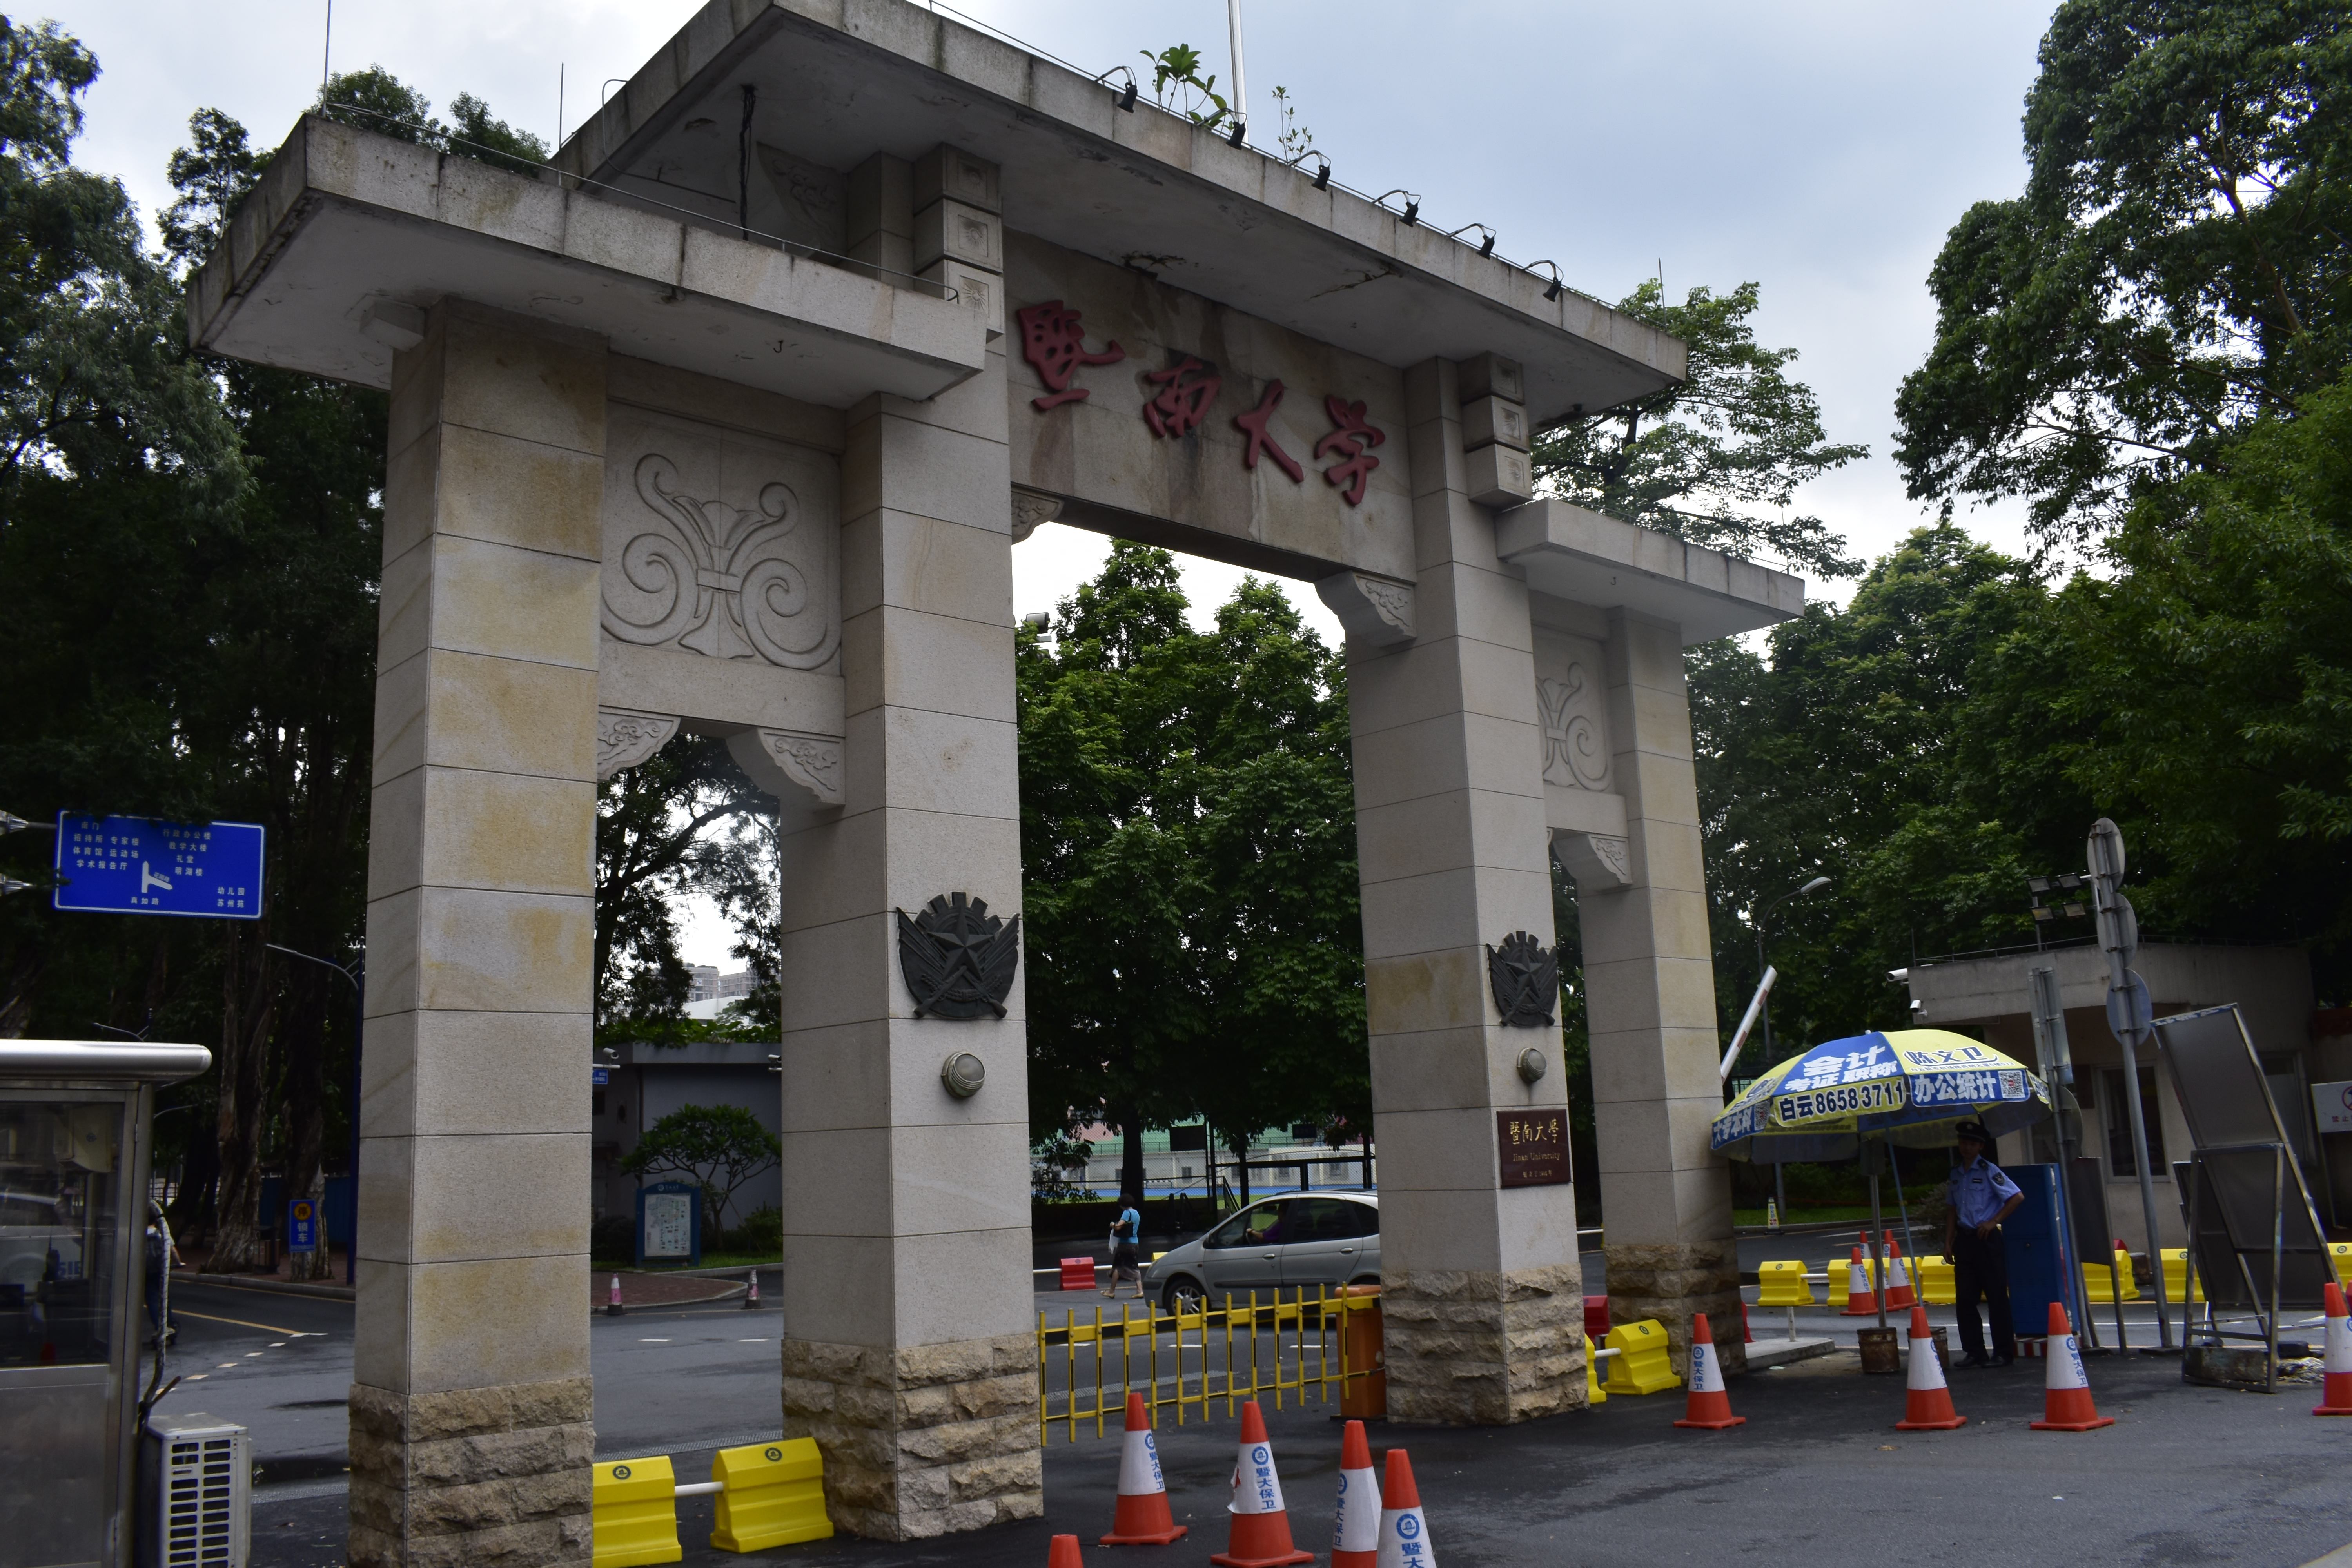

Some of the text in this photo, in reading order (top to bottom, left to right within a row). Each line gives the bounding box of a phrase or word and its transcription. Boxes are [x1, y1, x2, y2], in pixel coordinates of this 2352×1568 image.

[81, 822, 99, 830] 南门
[74, 834, 139, 846] 招待所 专家楼
[163, 829, 211, 840] 行政办公楼
[73, 846, 138, 858] 体育馆 运动场
[169, 842, 207, 851] 教学大楼
[76, 859, 127, 870] 学术报告厅
[177, 855, 194, 863] 礼堂
[175, 867, 203, 876] 明湖楼
[218, 886, 245, 895] 幼儿园
[217, 899, 244, 908] 苏州苑
[1803, 1045, 1885, 1077] 会计
[1785, 1061, 1897, 1092] 考证 职称
[1915, 1071, 1997, 1103] 办公统计
[1530, 1152, 1560, 1160] University
[297, 1222, 308, 1243] 锁车
[1694, 1361, 1704, 1390] 暨大保卫
[1149, 1452, 1163, 1490] 暨大保卫
[1256, 1467, 1275, 1510] 暨大保卫
